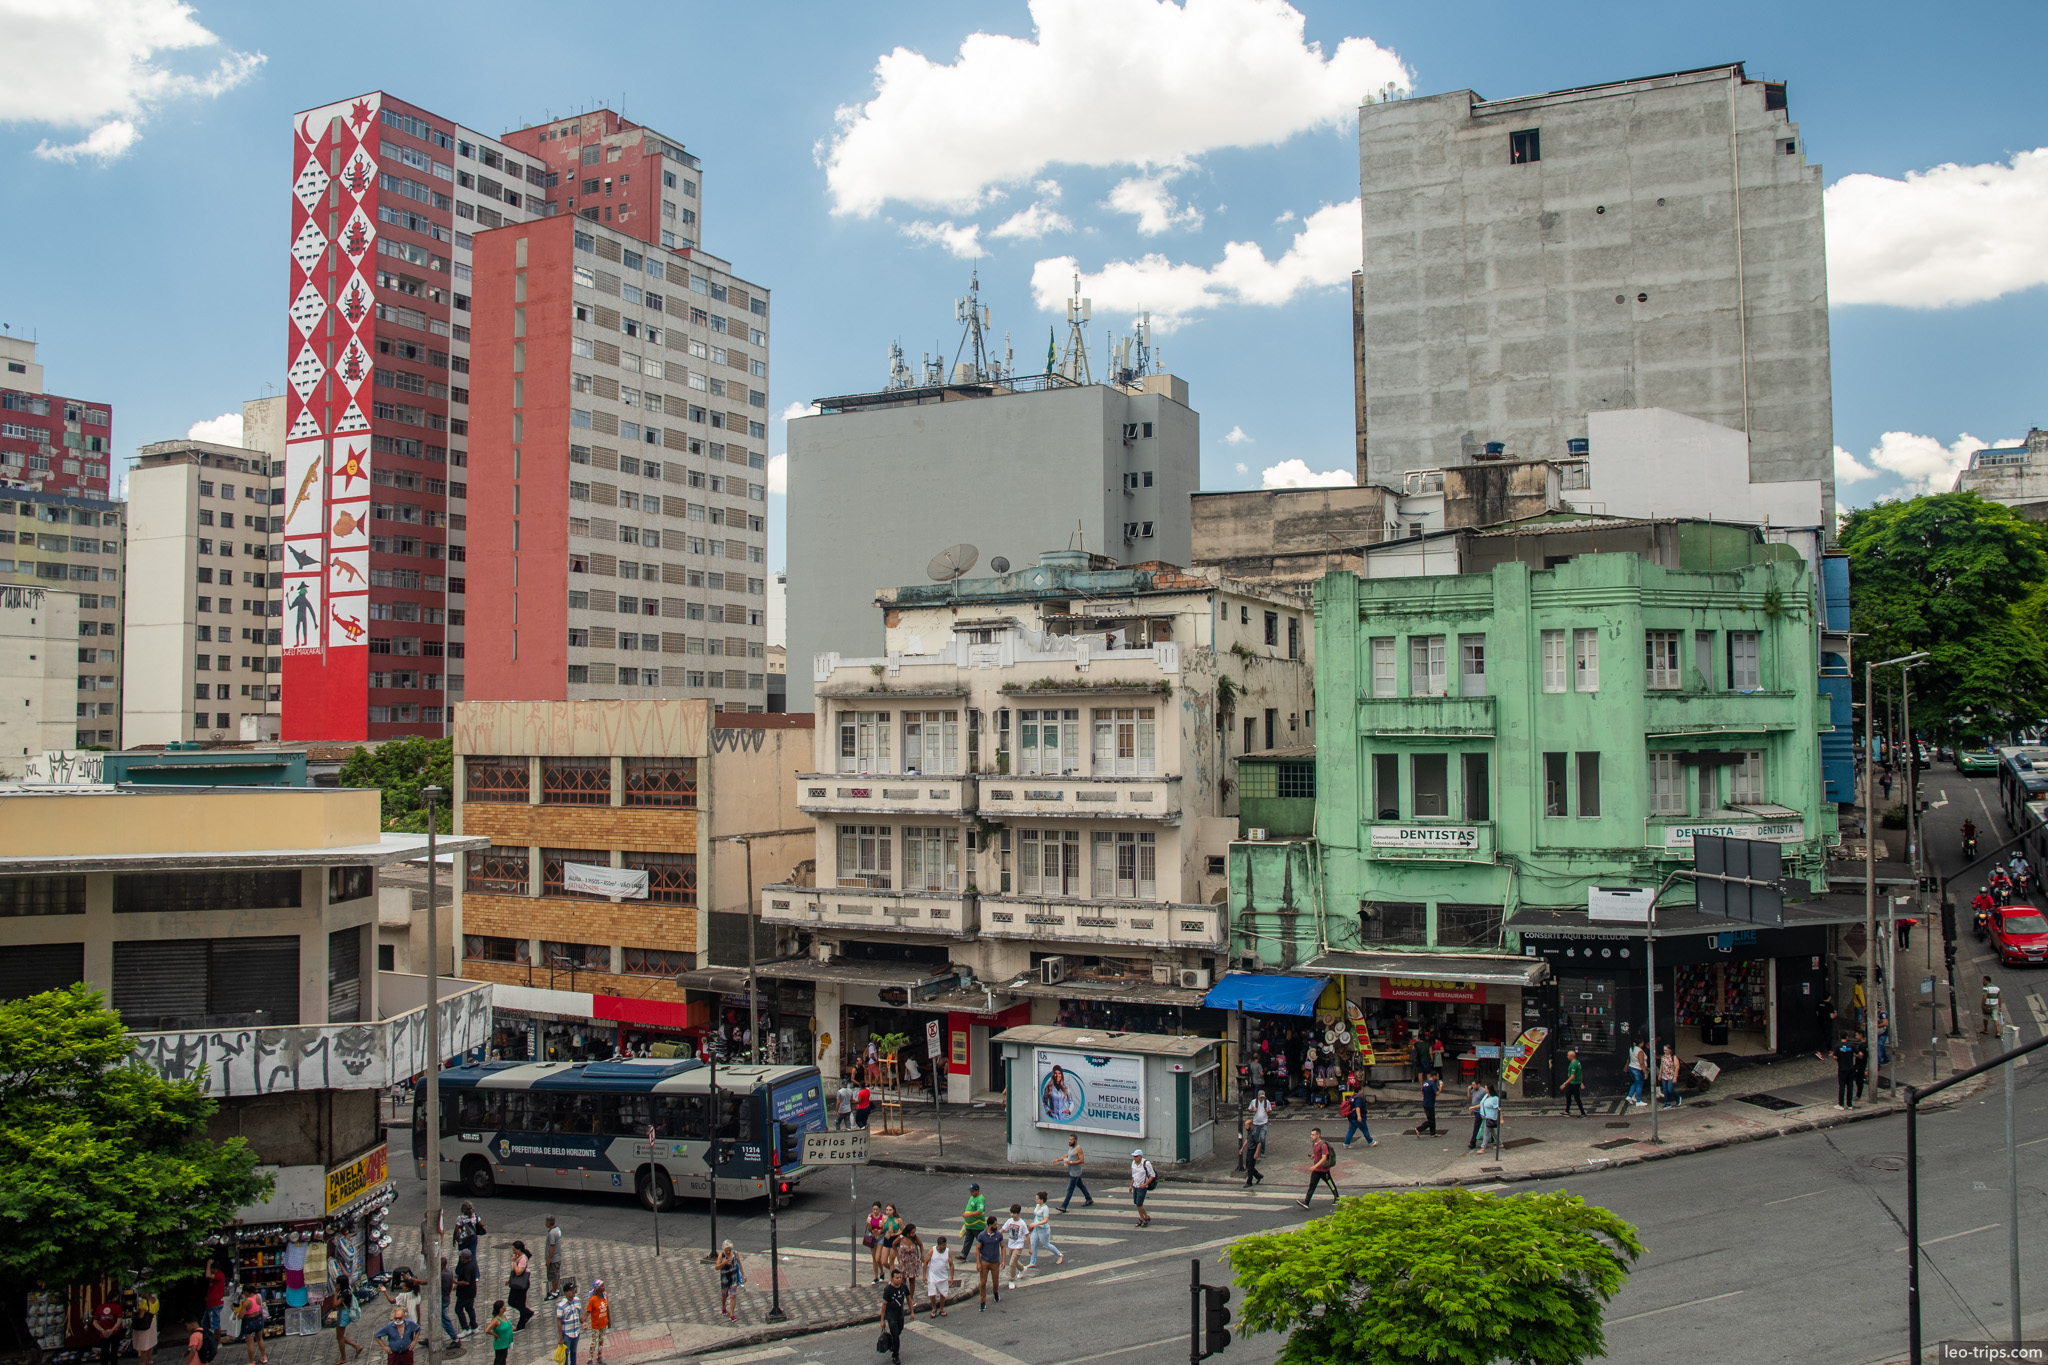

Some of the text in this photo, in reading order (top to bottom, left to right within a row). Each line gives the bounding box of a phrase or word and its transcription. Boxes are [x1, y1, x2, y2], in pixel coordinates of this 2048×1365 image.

[1400, 829, 1475, 840] DENTISTAS
[1676, 827, 1734, 838] DENTISTA
[1758, 825, 1794, 836] DENTISTA
[1524, 932, 1560, 940] CONSERTE
[1562, 933, 1581, 941] AQUI
[1734, 929, 1757, 941] LIKE
[1098, 1094, 1140, 1105] MEDICINA
[1087, 1101, 1122, 1109] EXCELÊNCIA
[1128, 1104, 1140, 1112] SER
[1087, 1108, 1140, 1122] UNIFENAS
[807, 1138, 846, 1147] Carlos
[511, 1145, 597, 1158] PREFEITURA DE BELO HORIZONTE
[809, 1151, 827, 1159] Pe.
[329, 1161, 364, 1191] PANELA
[330, 1173, 367, 1206] DE PRESSÃO
[690, 1182, 707, 1190] BELO
